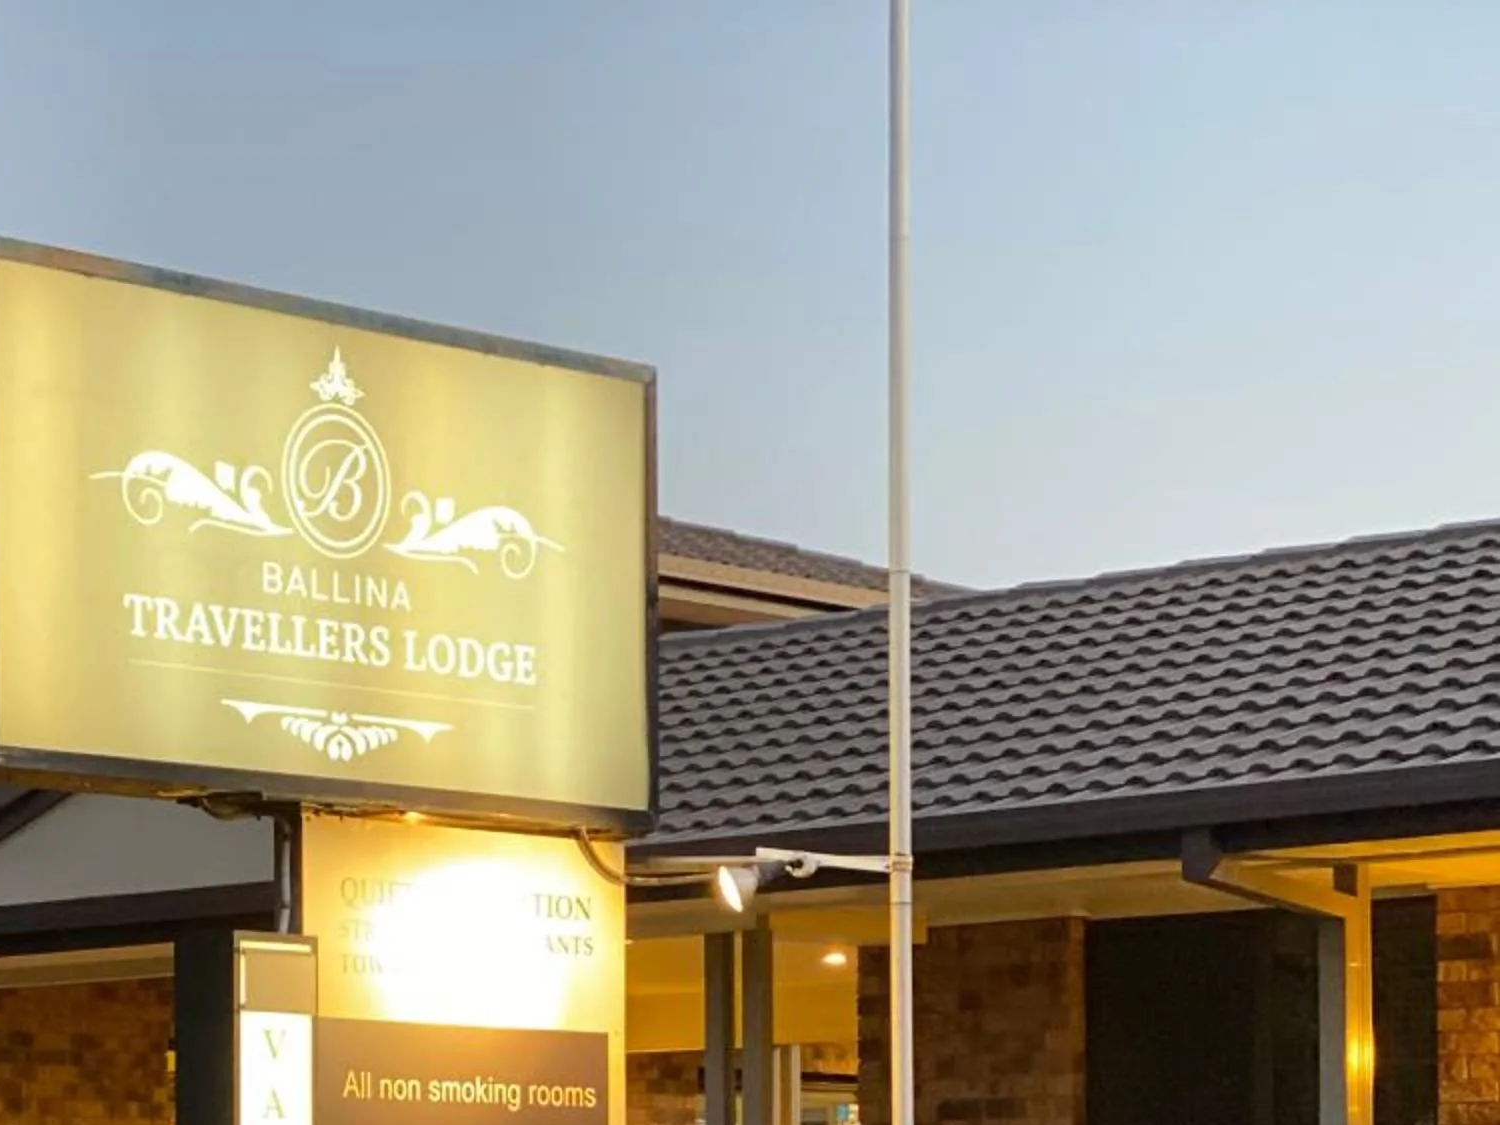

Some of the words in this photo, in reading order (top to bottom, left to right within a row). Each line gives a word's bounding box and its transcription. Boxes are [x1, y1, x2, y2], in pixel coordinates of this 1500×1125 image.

[299, 438, 369, 522] B
[261, 561, 413, 612] BALLINA
[122, 592, 392, 668] TRAVELLERS
[404, 631, 536, 685] LODGE
[342, 1070, 372, 1099] All
[379, 1078, 422, 1101] non
[428, 1075, 521, 1112] smoking
[528, 1084, 597, 1108] rooms
